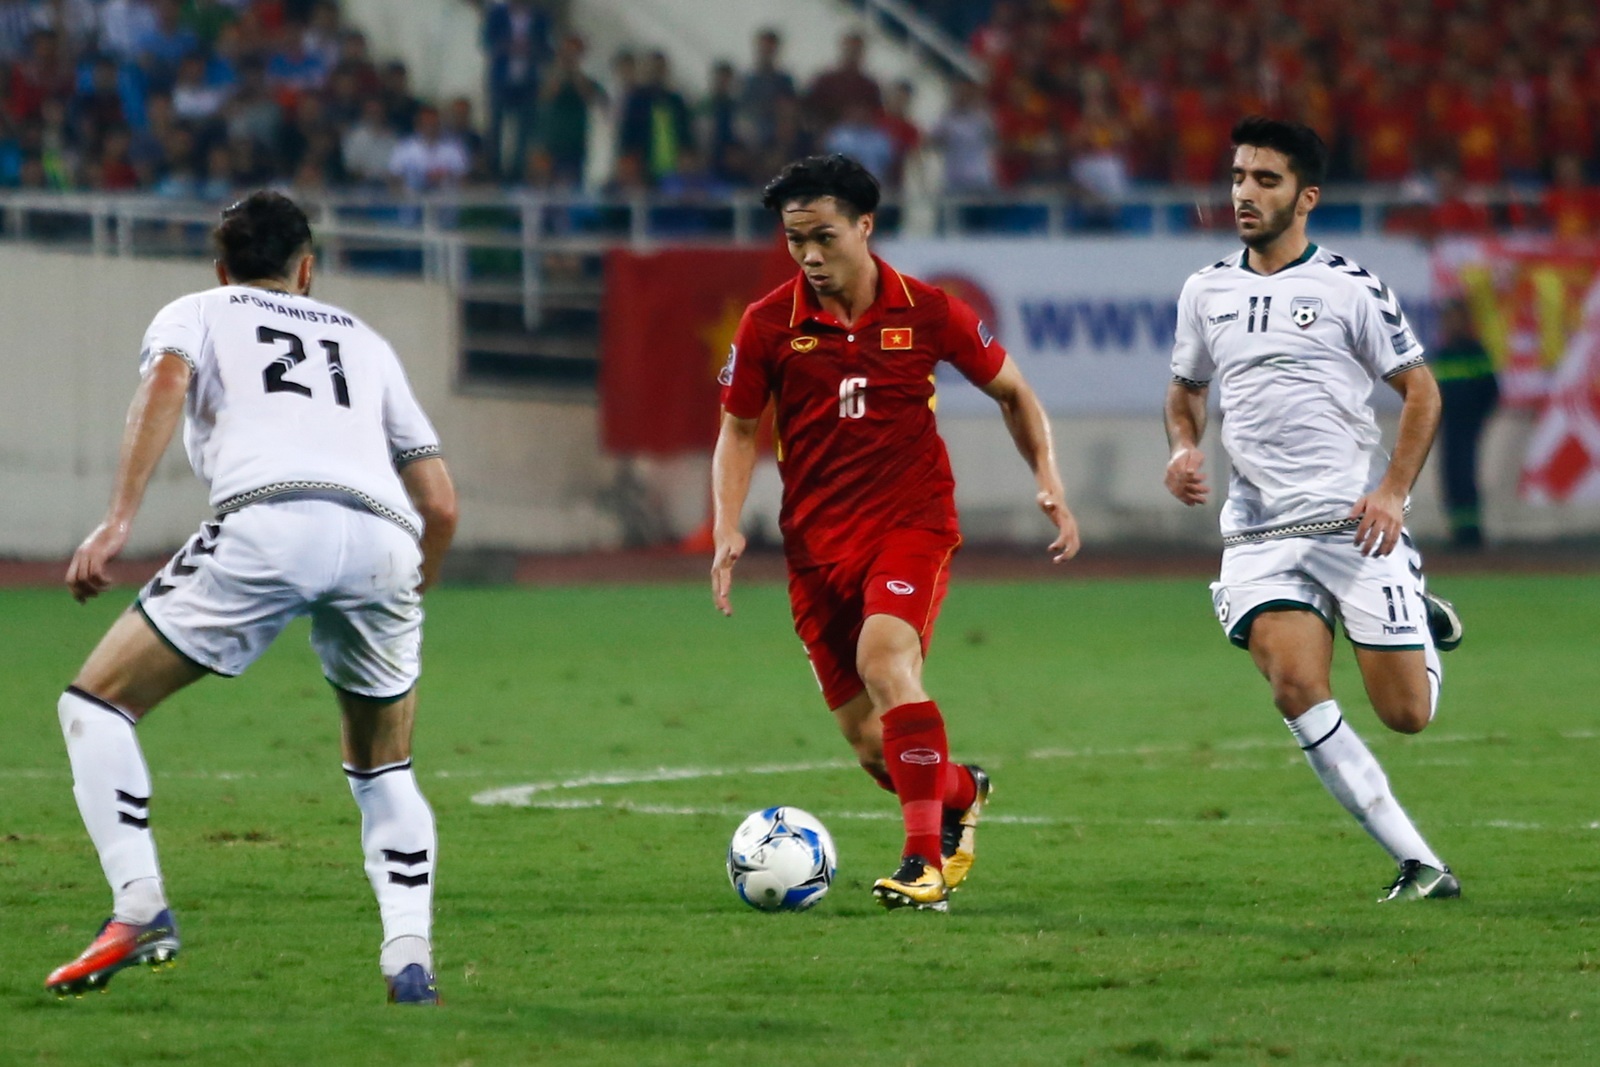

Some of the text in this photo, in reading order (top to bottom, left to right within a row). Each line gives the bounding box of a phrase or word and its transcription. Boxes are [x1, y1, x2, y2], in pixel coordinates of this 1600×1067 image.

[229, 294, 354, 328] AFGHANISTAN
[1247, 296, 1272, 333] 11
[256, 325, 351, 409] 21
[1382, 585, 1409, 622] 11
